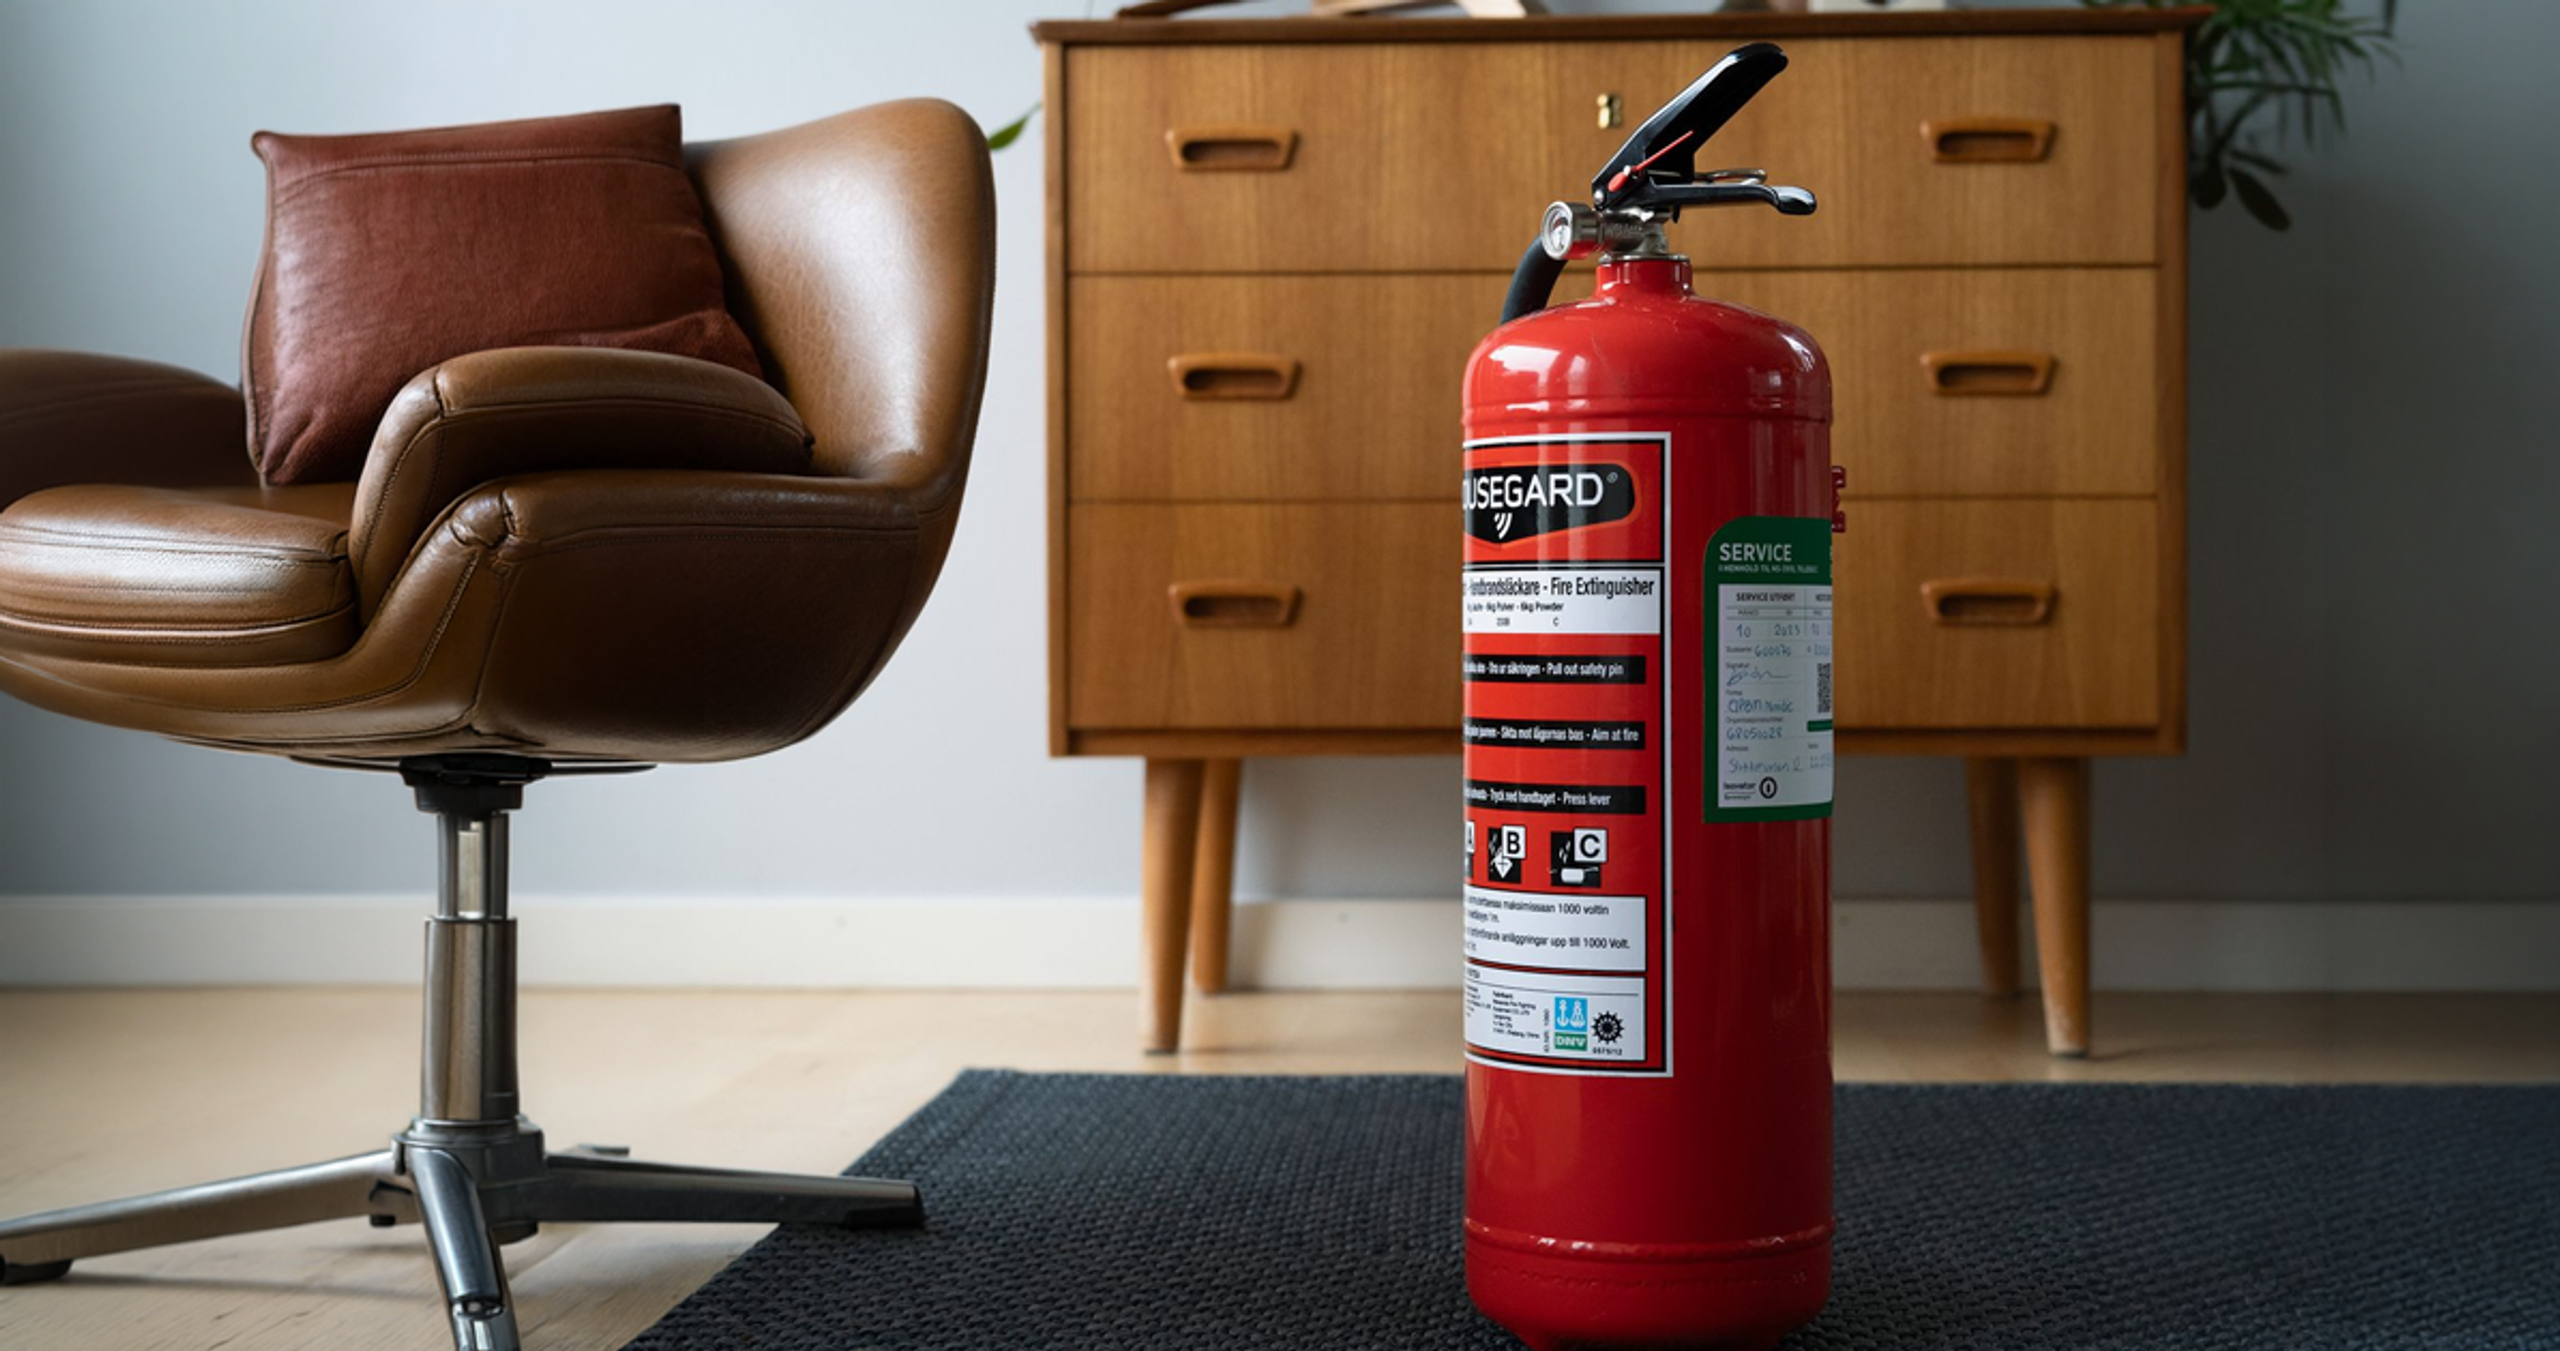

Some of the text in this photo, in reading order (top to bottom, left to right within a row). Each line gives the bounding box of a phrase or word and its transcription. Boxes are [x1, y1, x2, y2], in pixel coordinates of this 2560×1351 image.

[1719, 542, 1792, 562] SERVICE
[1551, 577, 1573, 596] Fire
[1576, 577, 1654, 599] Extinguisher
[1535, 601, 1564, 611] Powder
[1547, 663, 1562, 675] Pull
[1563, 664, 1578, 675] out
[1580, 663, 1606, 678] safety
[1608, 663, 1624, 678] pin
[1591, 728, 1609, 741] Aim
[1611, 729, 1621, 741] at
[1623, 728, 1639, 741] fire
[1563, 791, 1586, 805] Press
[1588, 791, 1611, 805] lever
[1506, 831, 1521, 854] B
[1580, 834, 1600, 858] C
[1559, 903, 1581, 915] 1000
[1550, 938, 1567, 949] upp
[1583, 938, 1607, 949] 1000
[1609, 938, 1630, 949] Volt.
[1556, 1036, 1586, 1048] DNV
